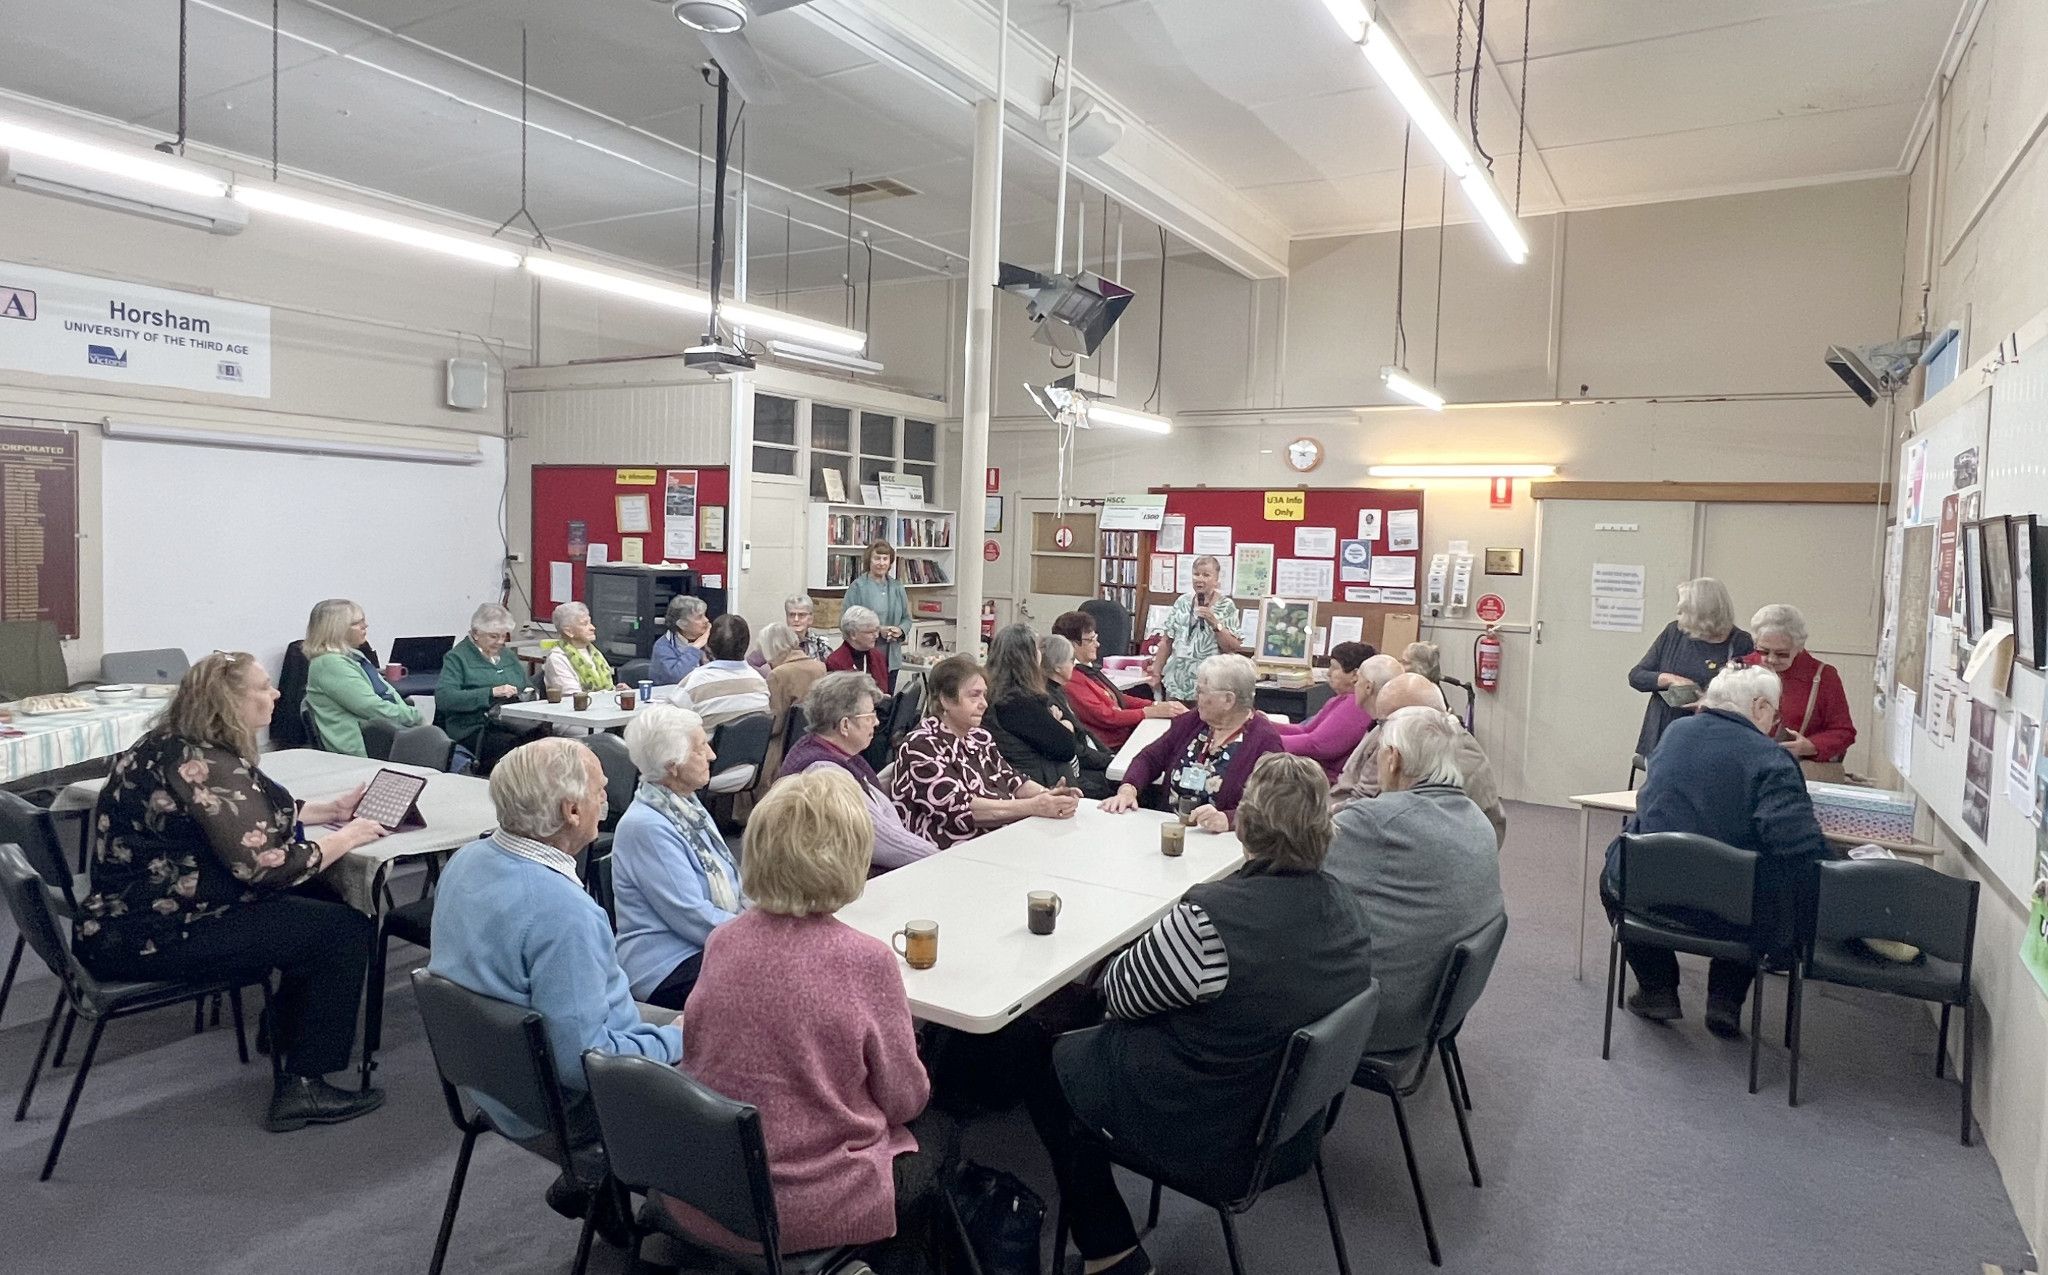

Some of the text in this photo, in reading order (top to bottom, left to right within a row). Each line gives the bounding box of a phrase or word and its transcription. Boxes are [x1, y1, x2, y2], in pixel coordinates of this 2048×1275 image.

[110, 300, 210, 335] Horsham
[64, 320, 249, 356] UNIVERSITY OF THE THIRD AGE
[0, 443, 64, 455] ORPORATED
[1106, 496, 1126, 504] HSCC
[1274, 508, 1294, 517] Only
